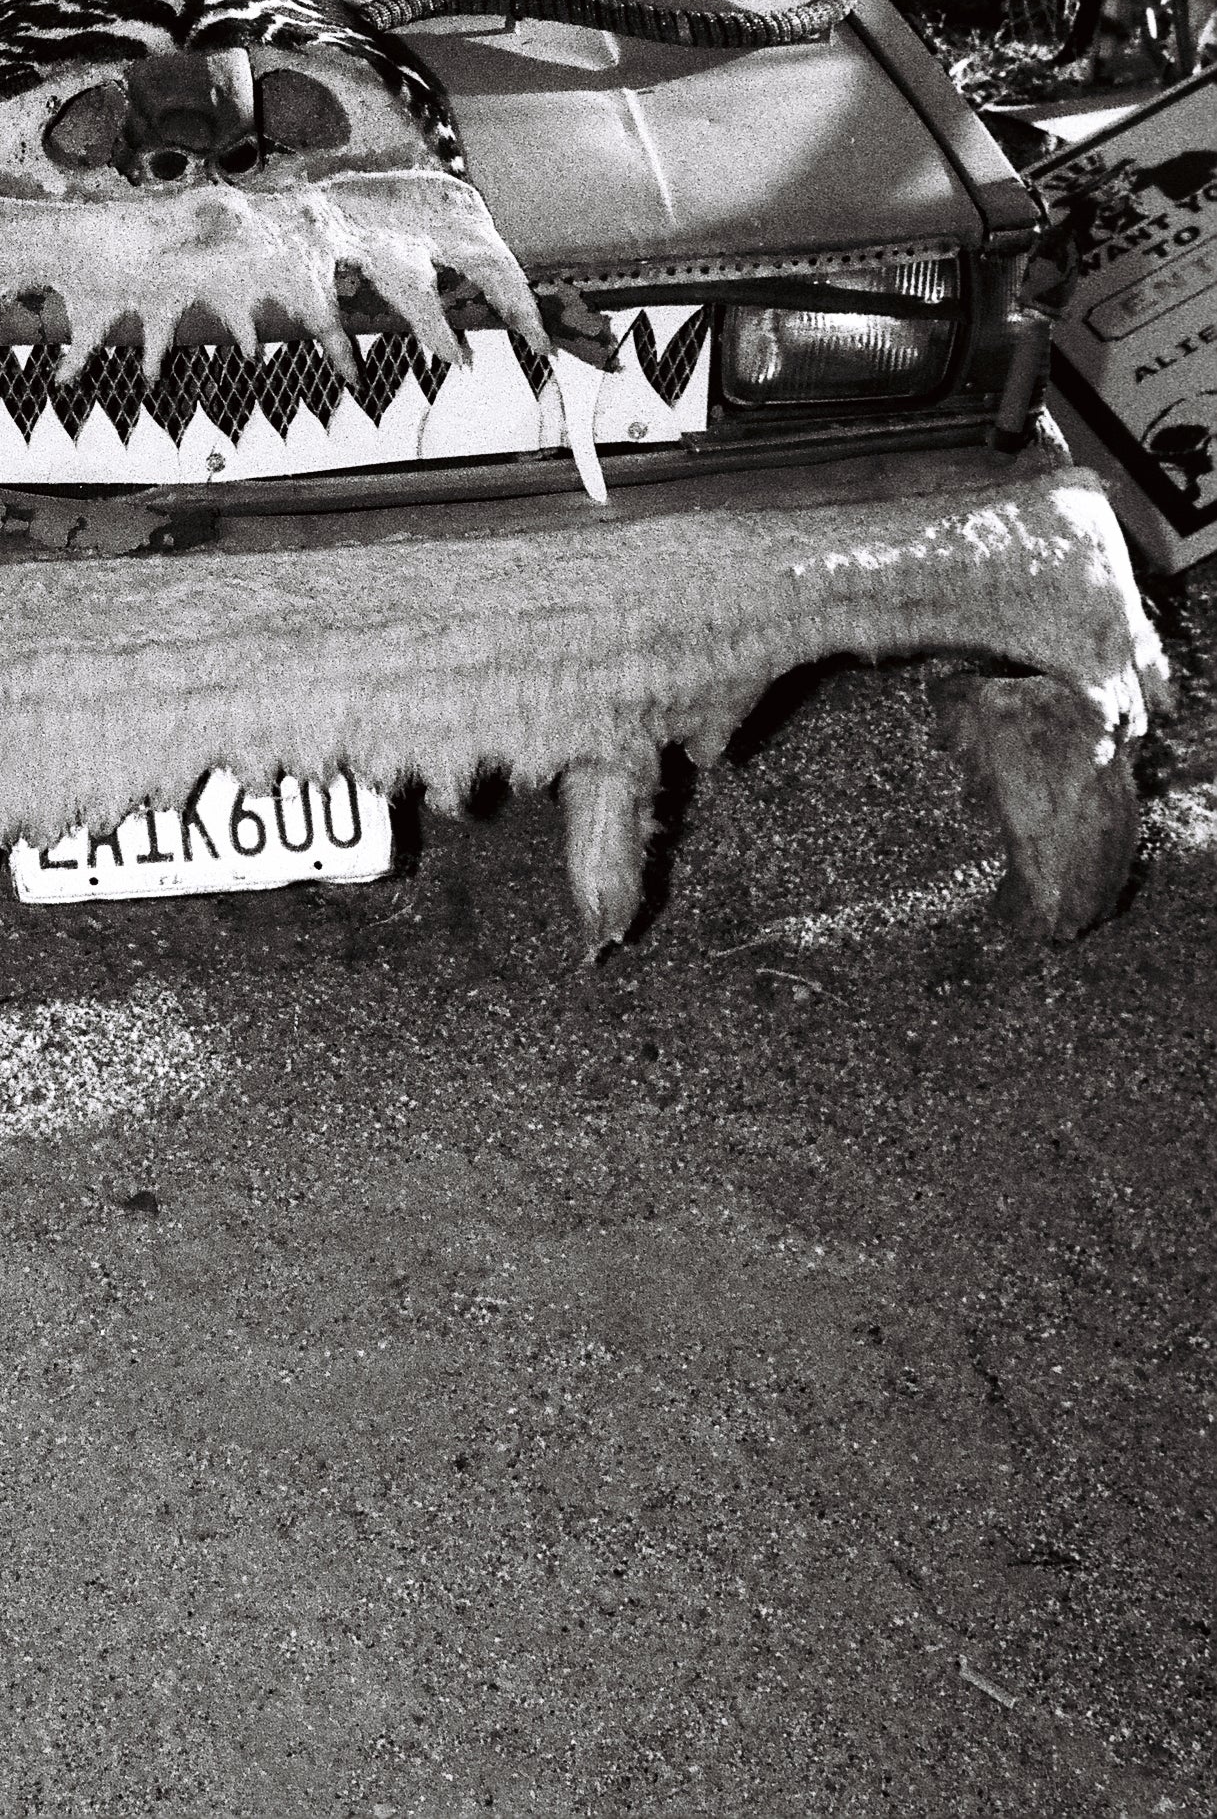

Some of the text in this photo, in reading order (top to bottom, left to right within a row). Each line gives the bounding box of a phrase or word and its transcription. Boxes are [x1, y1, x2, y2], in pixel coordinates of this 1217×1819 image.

[1081, 212, 1170, 277] WANT
[1142, 225, 1200, 259] TO
[39, 760, 362, 870] 1K600
